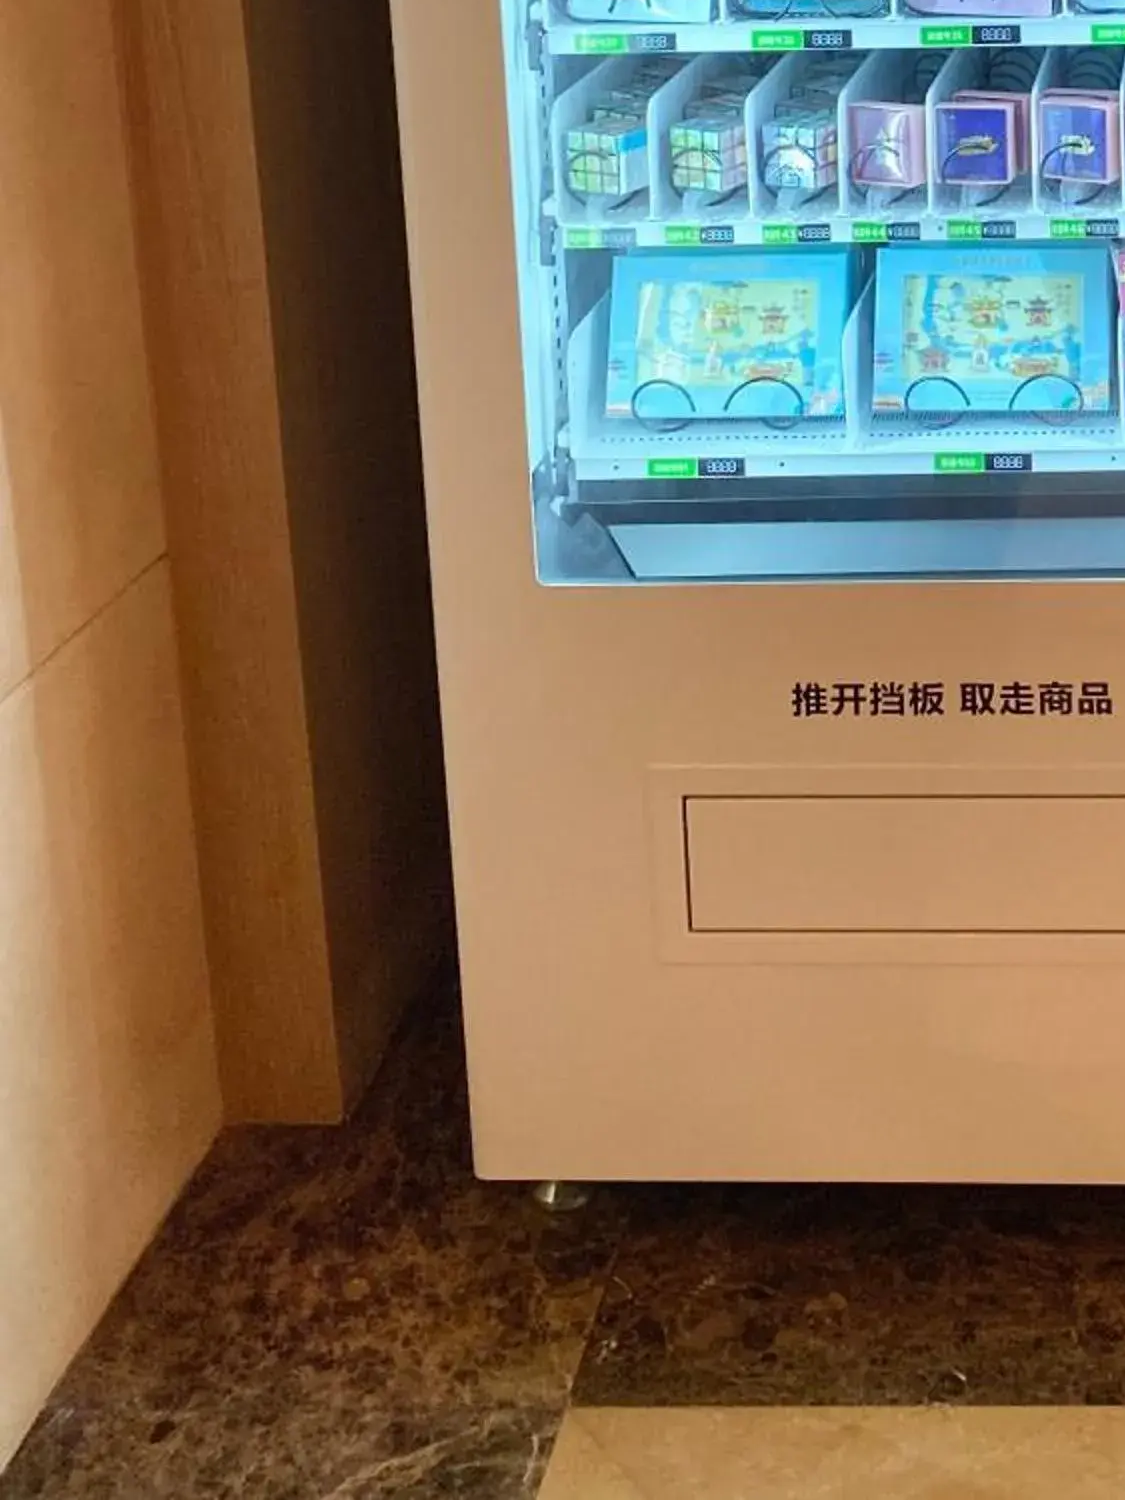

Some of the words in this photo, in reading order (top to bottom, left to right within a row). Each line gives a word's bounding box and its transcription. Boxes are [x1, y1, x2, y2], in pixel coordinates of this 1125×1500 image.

[791, 682, 945, 717] 推开挡板
[959, 682, 1113, 717] 取走商品
